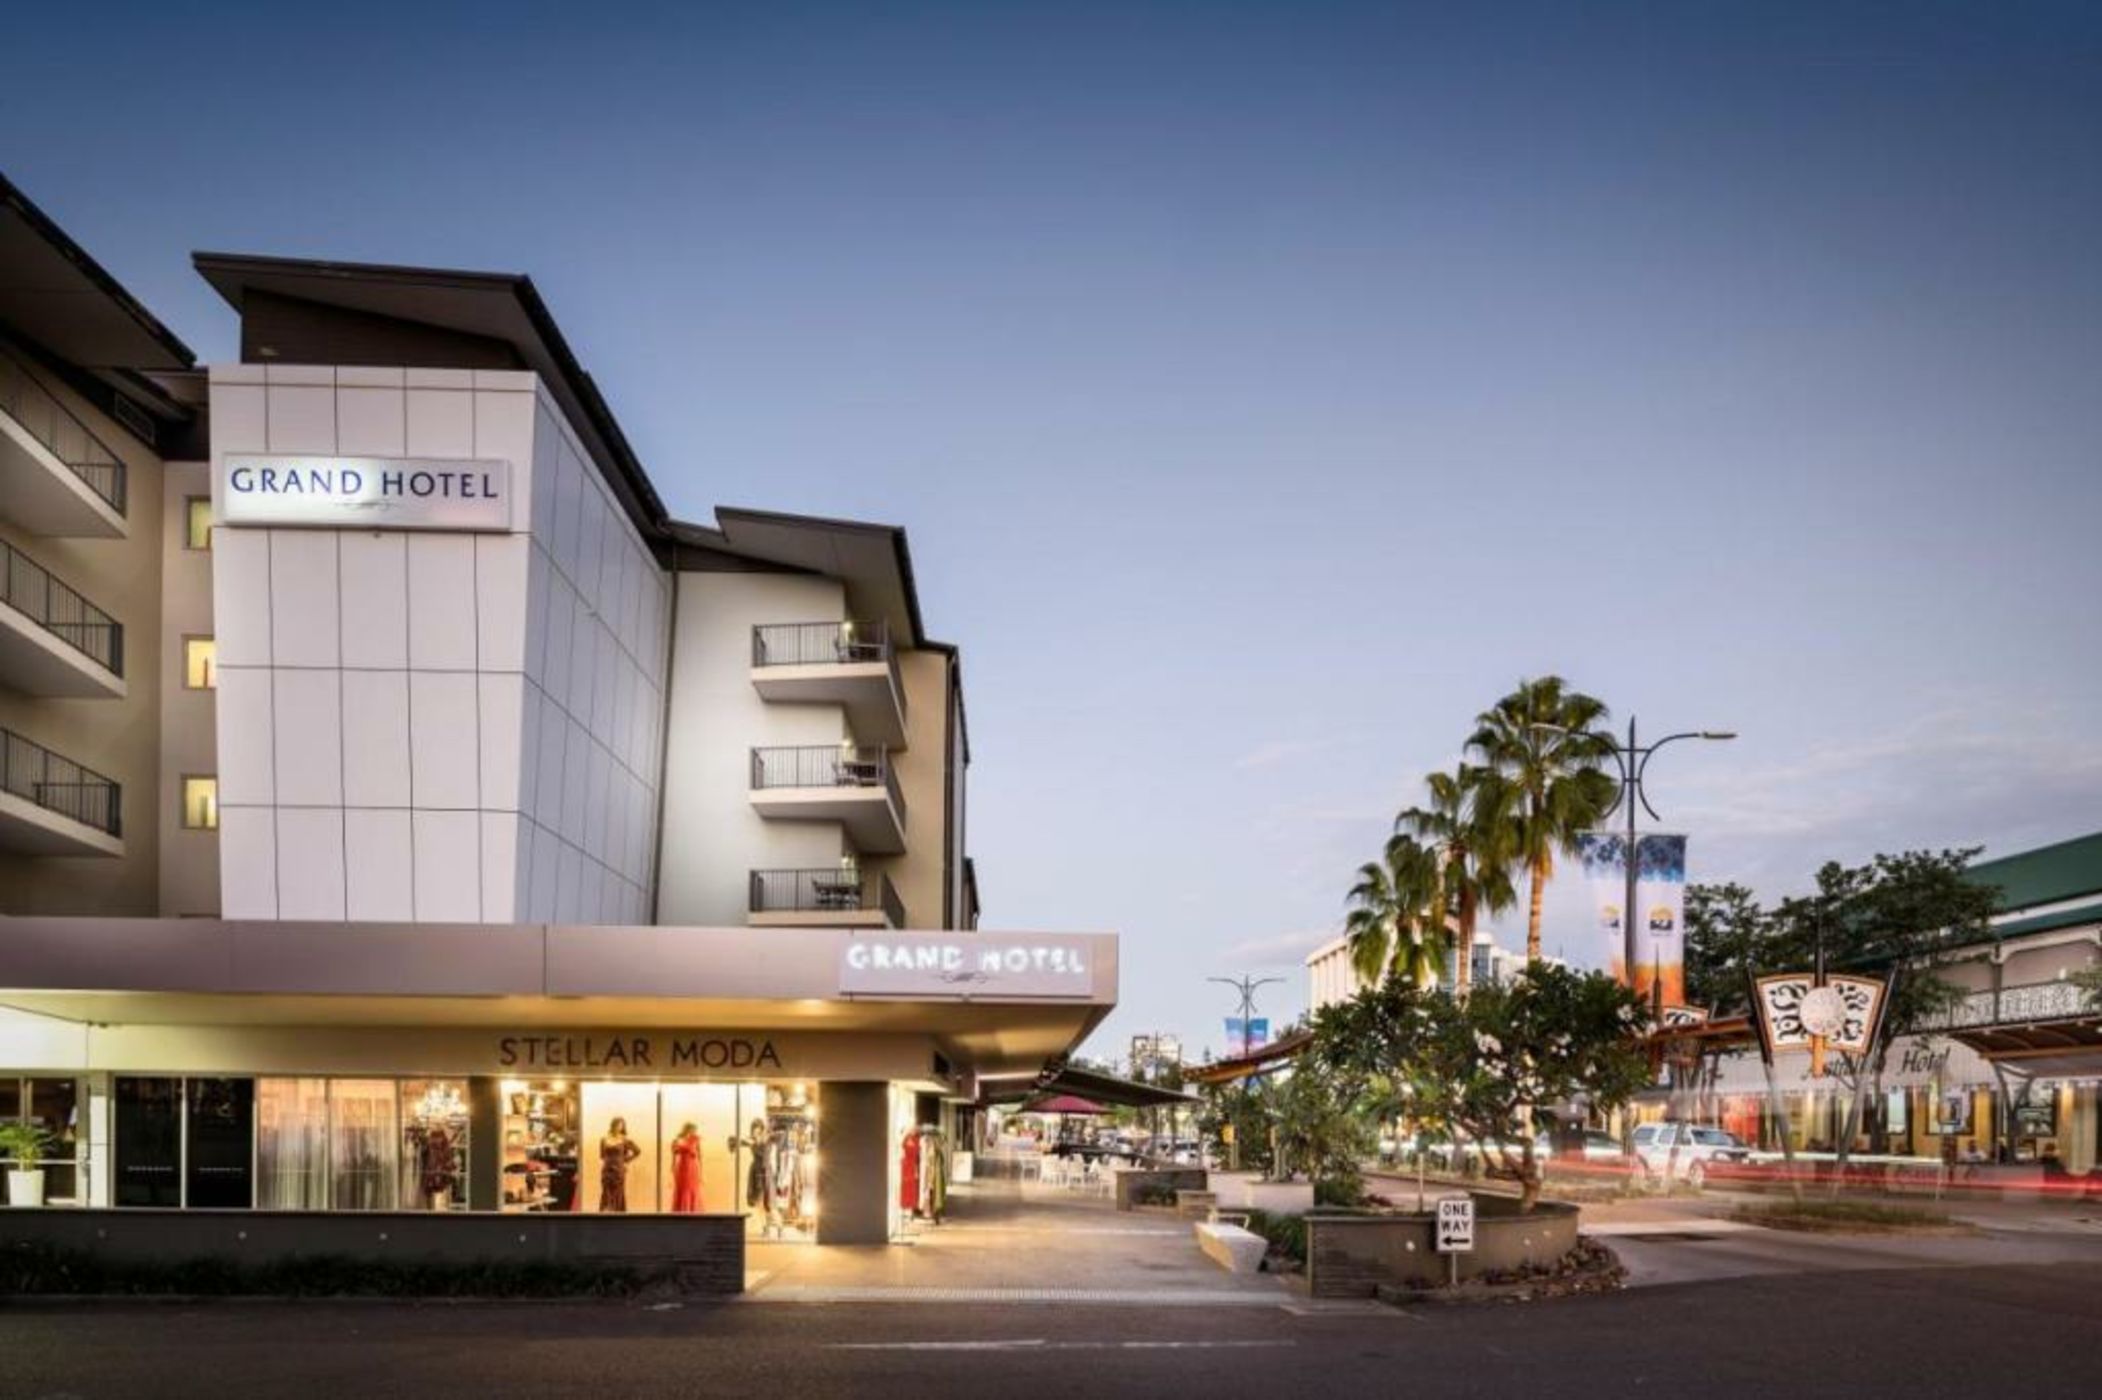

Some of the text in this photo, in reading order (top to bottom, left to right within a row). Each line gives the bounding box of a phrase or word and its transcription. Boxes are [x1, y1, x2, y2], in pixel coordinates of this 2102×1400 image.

[231, 467, 499, 498] GRAND HOTEL
[848, 944, 1085, 973] GRAND HOTEL
[501, 1037, 782, 1068] STELLAR MODA
[1442, 1202, 1470, 1216] ONE
[1441, 1219, 1471, 1233] WAY
